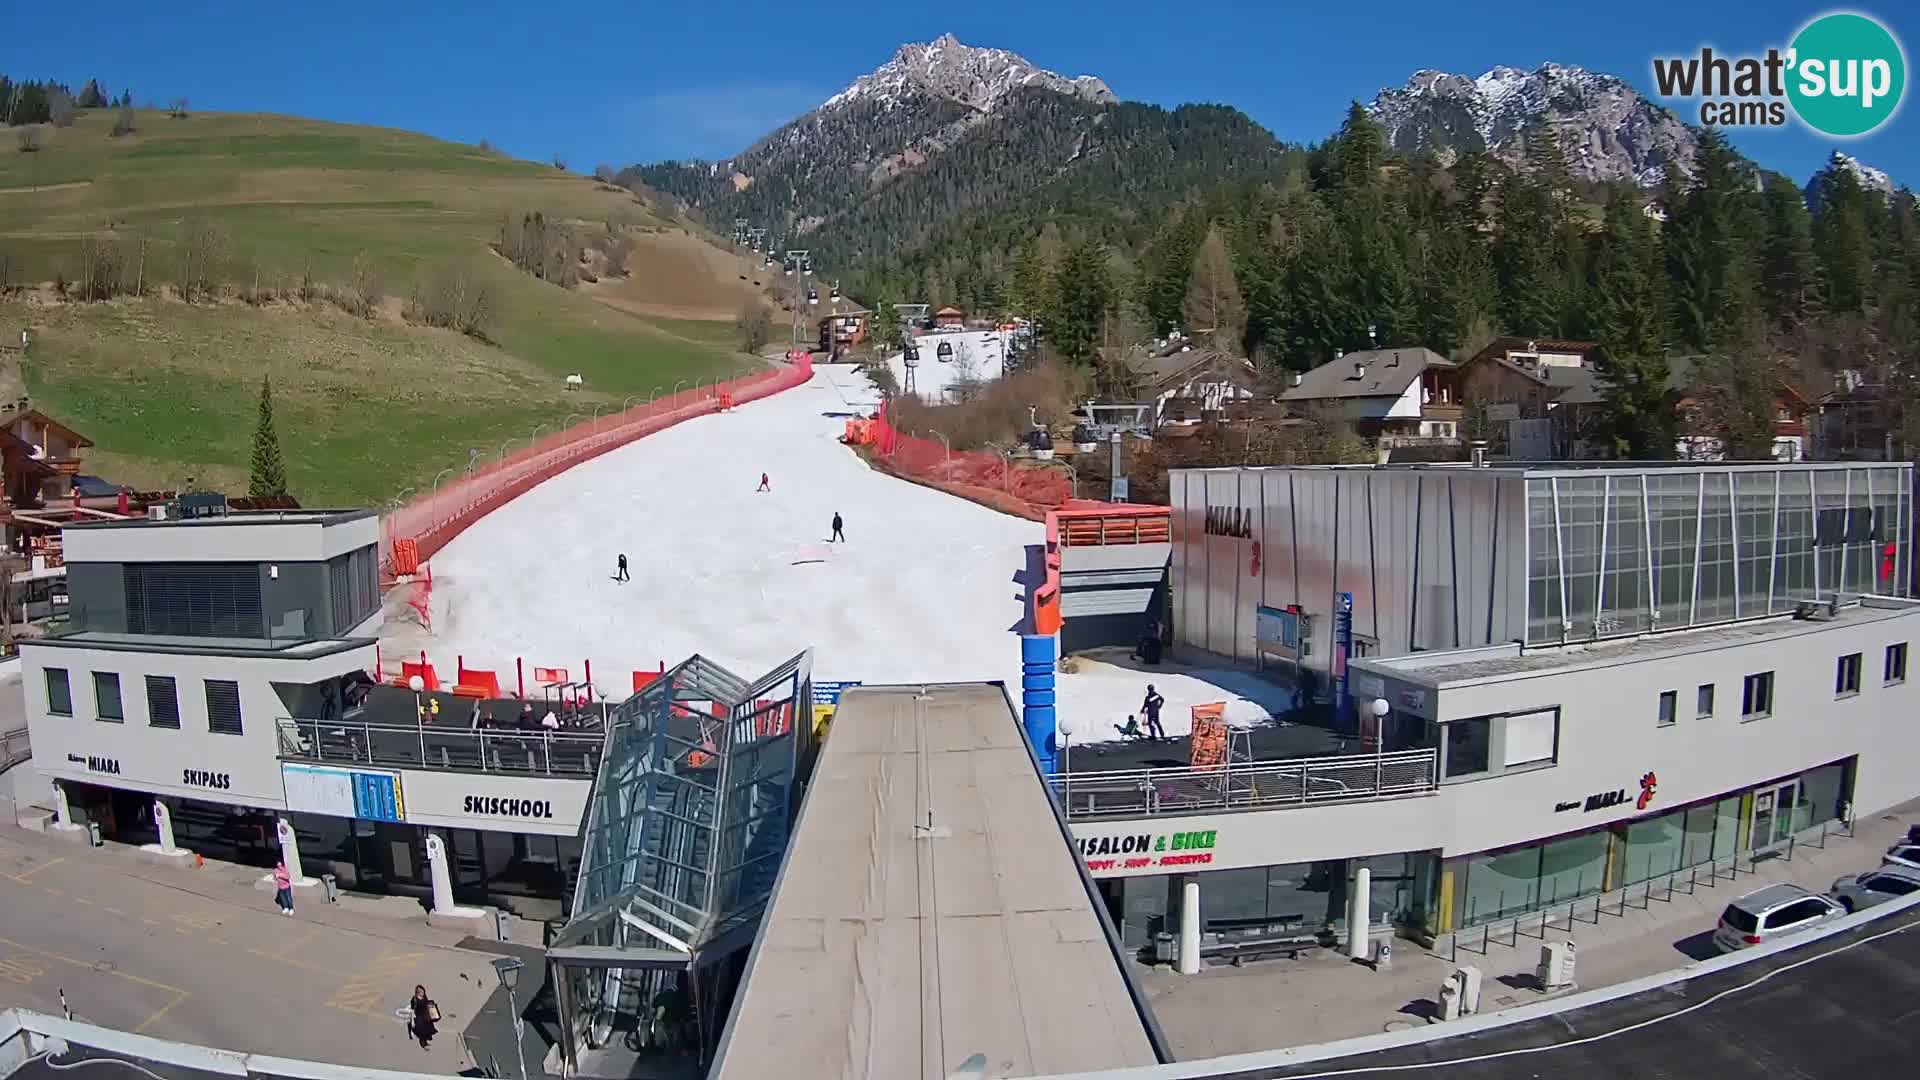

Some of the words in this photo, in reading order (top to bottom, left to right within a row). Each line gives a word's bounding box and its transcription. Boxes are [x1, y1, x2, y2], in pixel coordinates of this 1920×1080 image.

[1205, 506, 1252, 539] MIARA
[88, 756, 121, 775] MIARA
[183, 769, 230, 789] SKIPASS
[464, 795, 553, 818] SKISCHOOL
[1075, 835, 1151, 856] ISALON
[1154, 836, 1166, 851] &
[1171, 831, 1217, 850] BIKE
